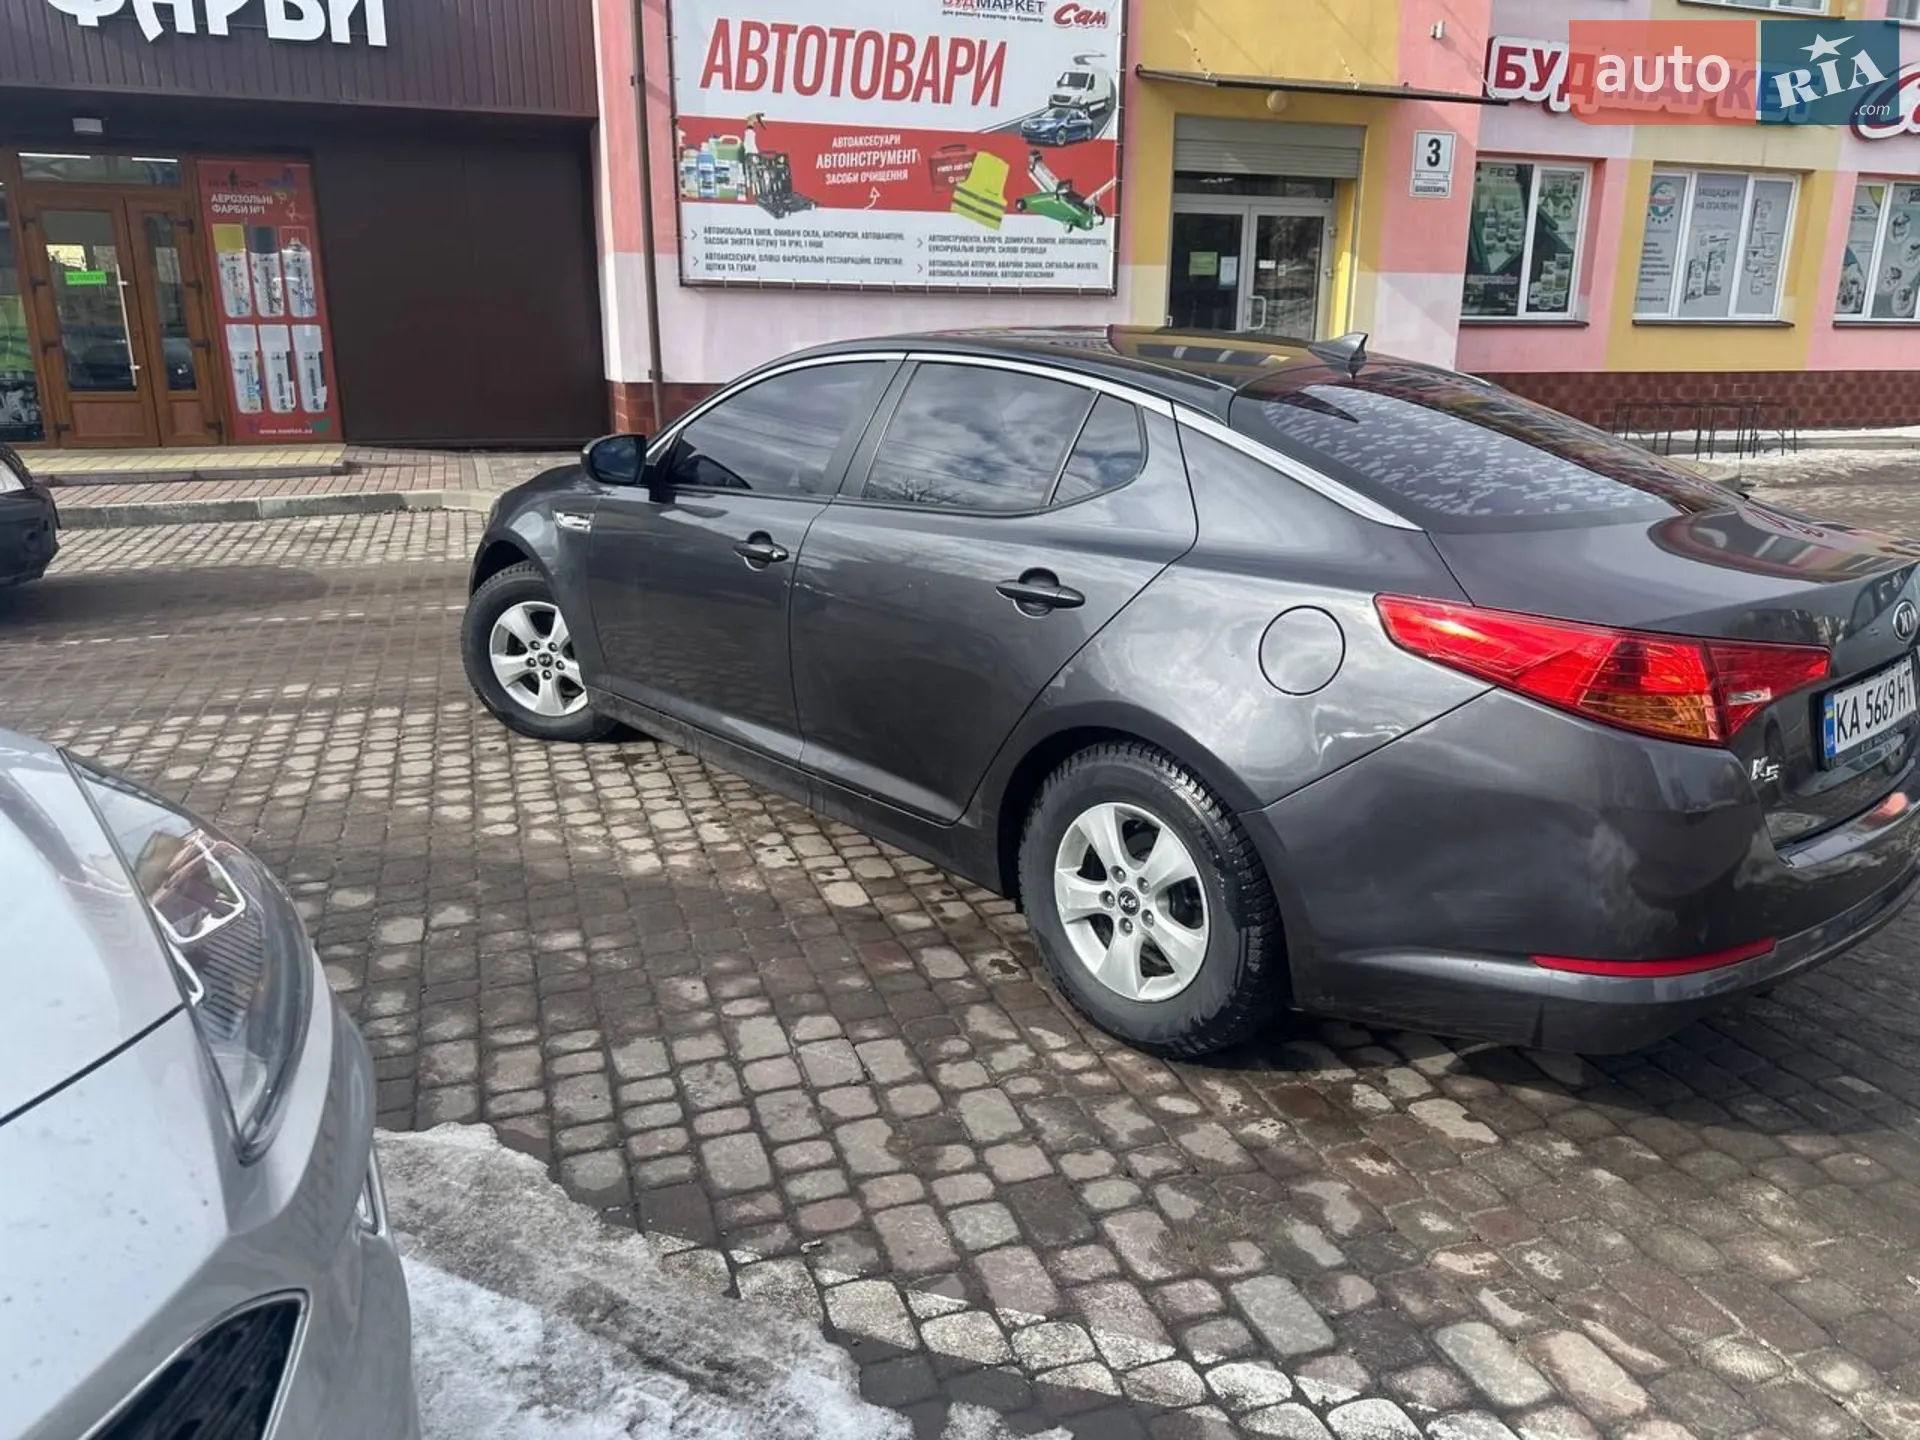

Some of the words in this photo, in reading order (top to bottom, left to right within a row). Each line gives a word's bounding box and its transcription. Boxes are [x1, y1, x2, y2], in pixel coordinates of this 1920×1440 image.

[700, 18, 1007, 107] АВТОТОВАРИ
[832, 134, 901, 148] АВТОАКСЕСУАРИ
[1426, 138, 1441, 167] 3
[825, 171, 859, 185] ЗАСОБИ
[860, 169, 908, 182] ОЧИЩЕННЯ
[211, 204, 248, 214] ФАРБИ
[1836, 695, 1861, 744] KA
[1865, 679, 1895, 730] 5669
